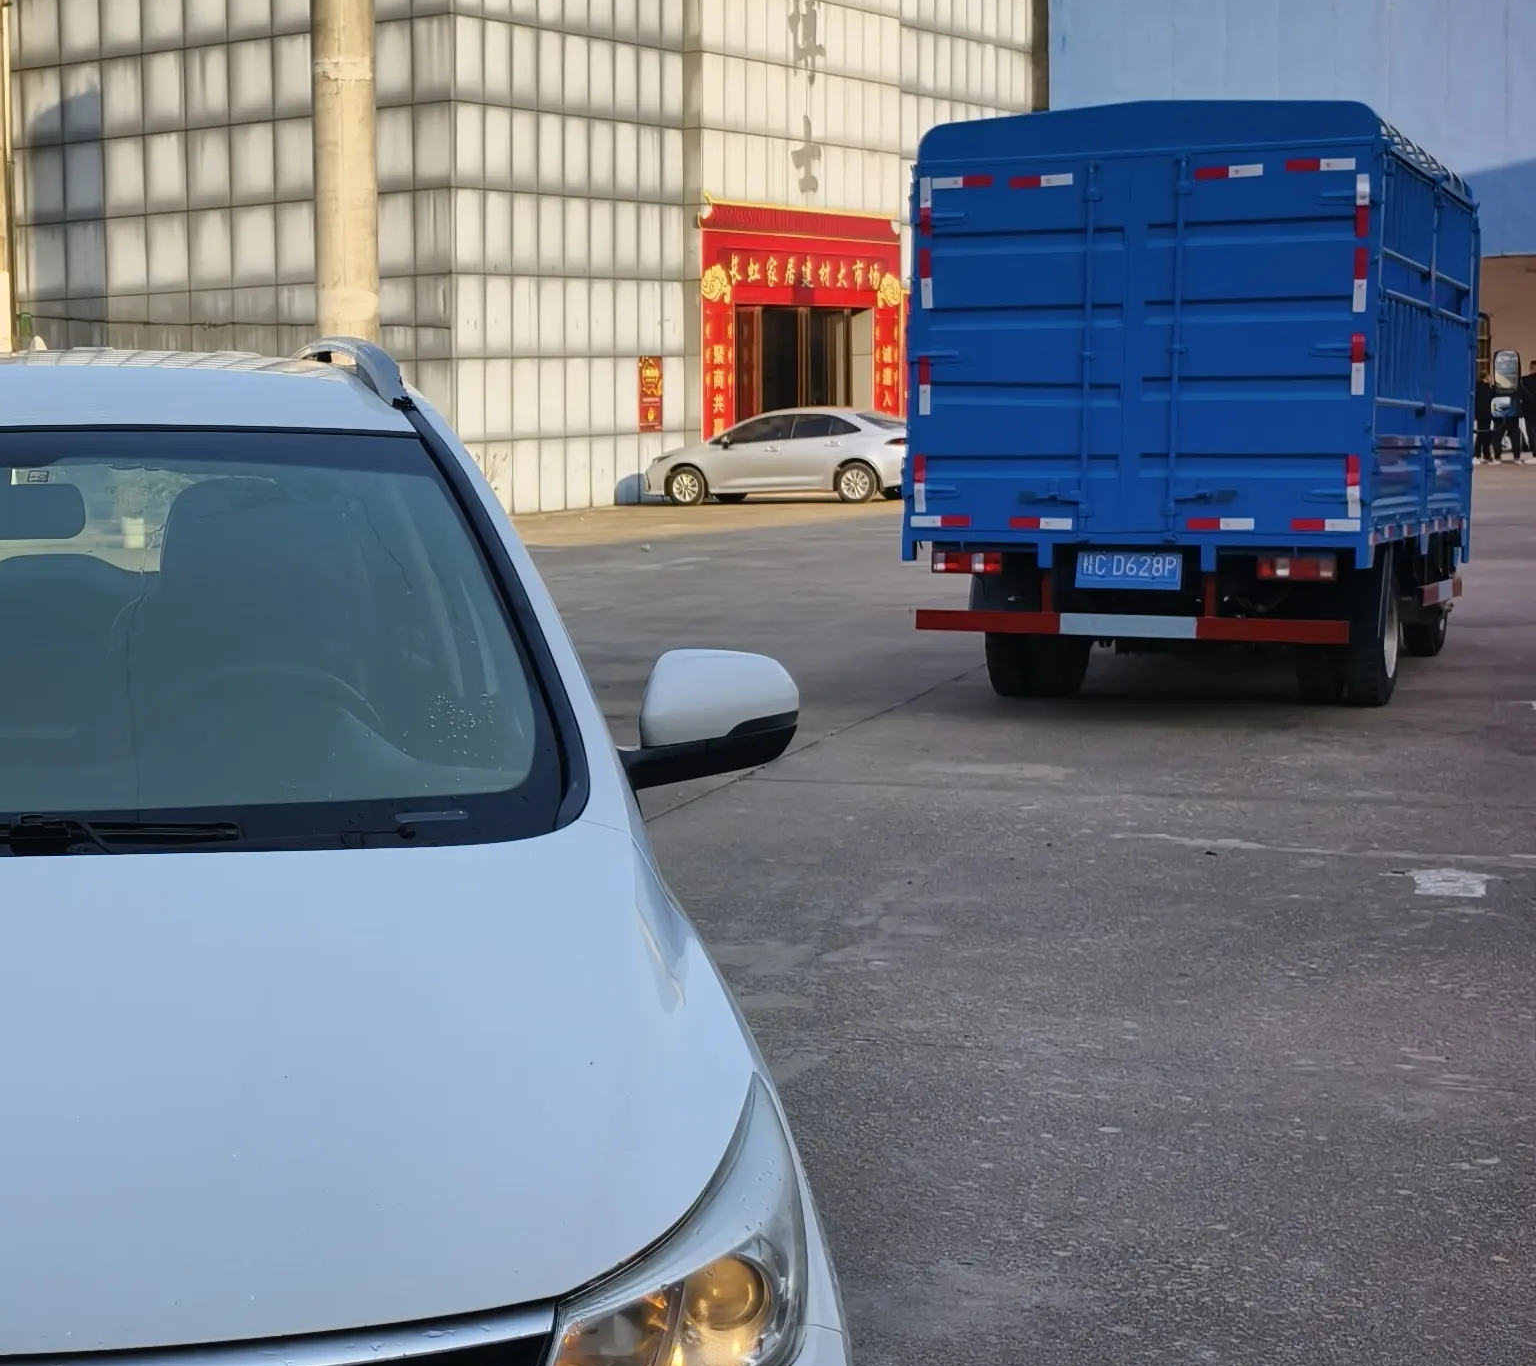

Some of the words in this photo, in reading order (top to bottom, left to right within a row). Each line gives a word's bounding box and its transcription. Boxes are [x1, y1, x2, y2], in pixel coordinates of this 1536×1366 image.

[728, 252, 881, 291] 长虹家居建材大市场
